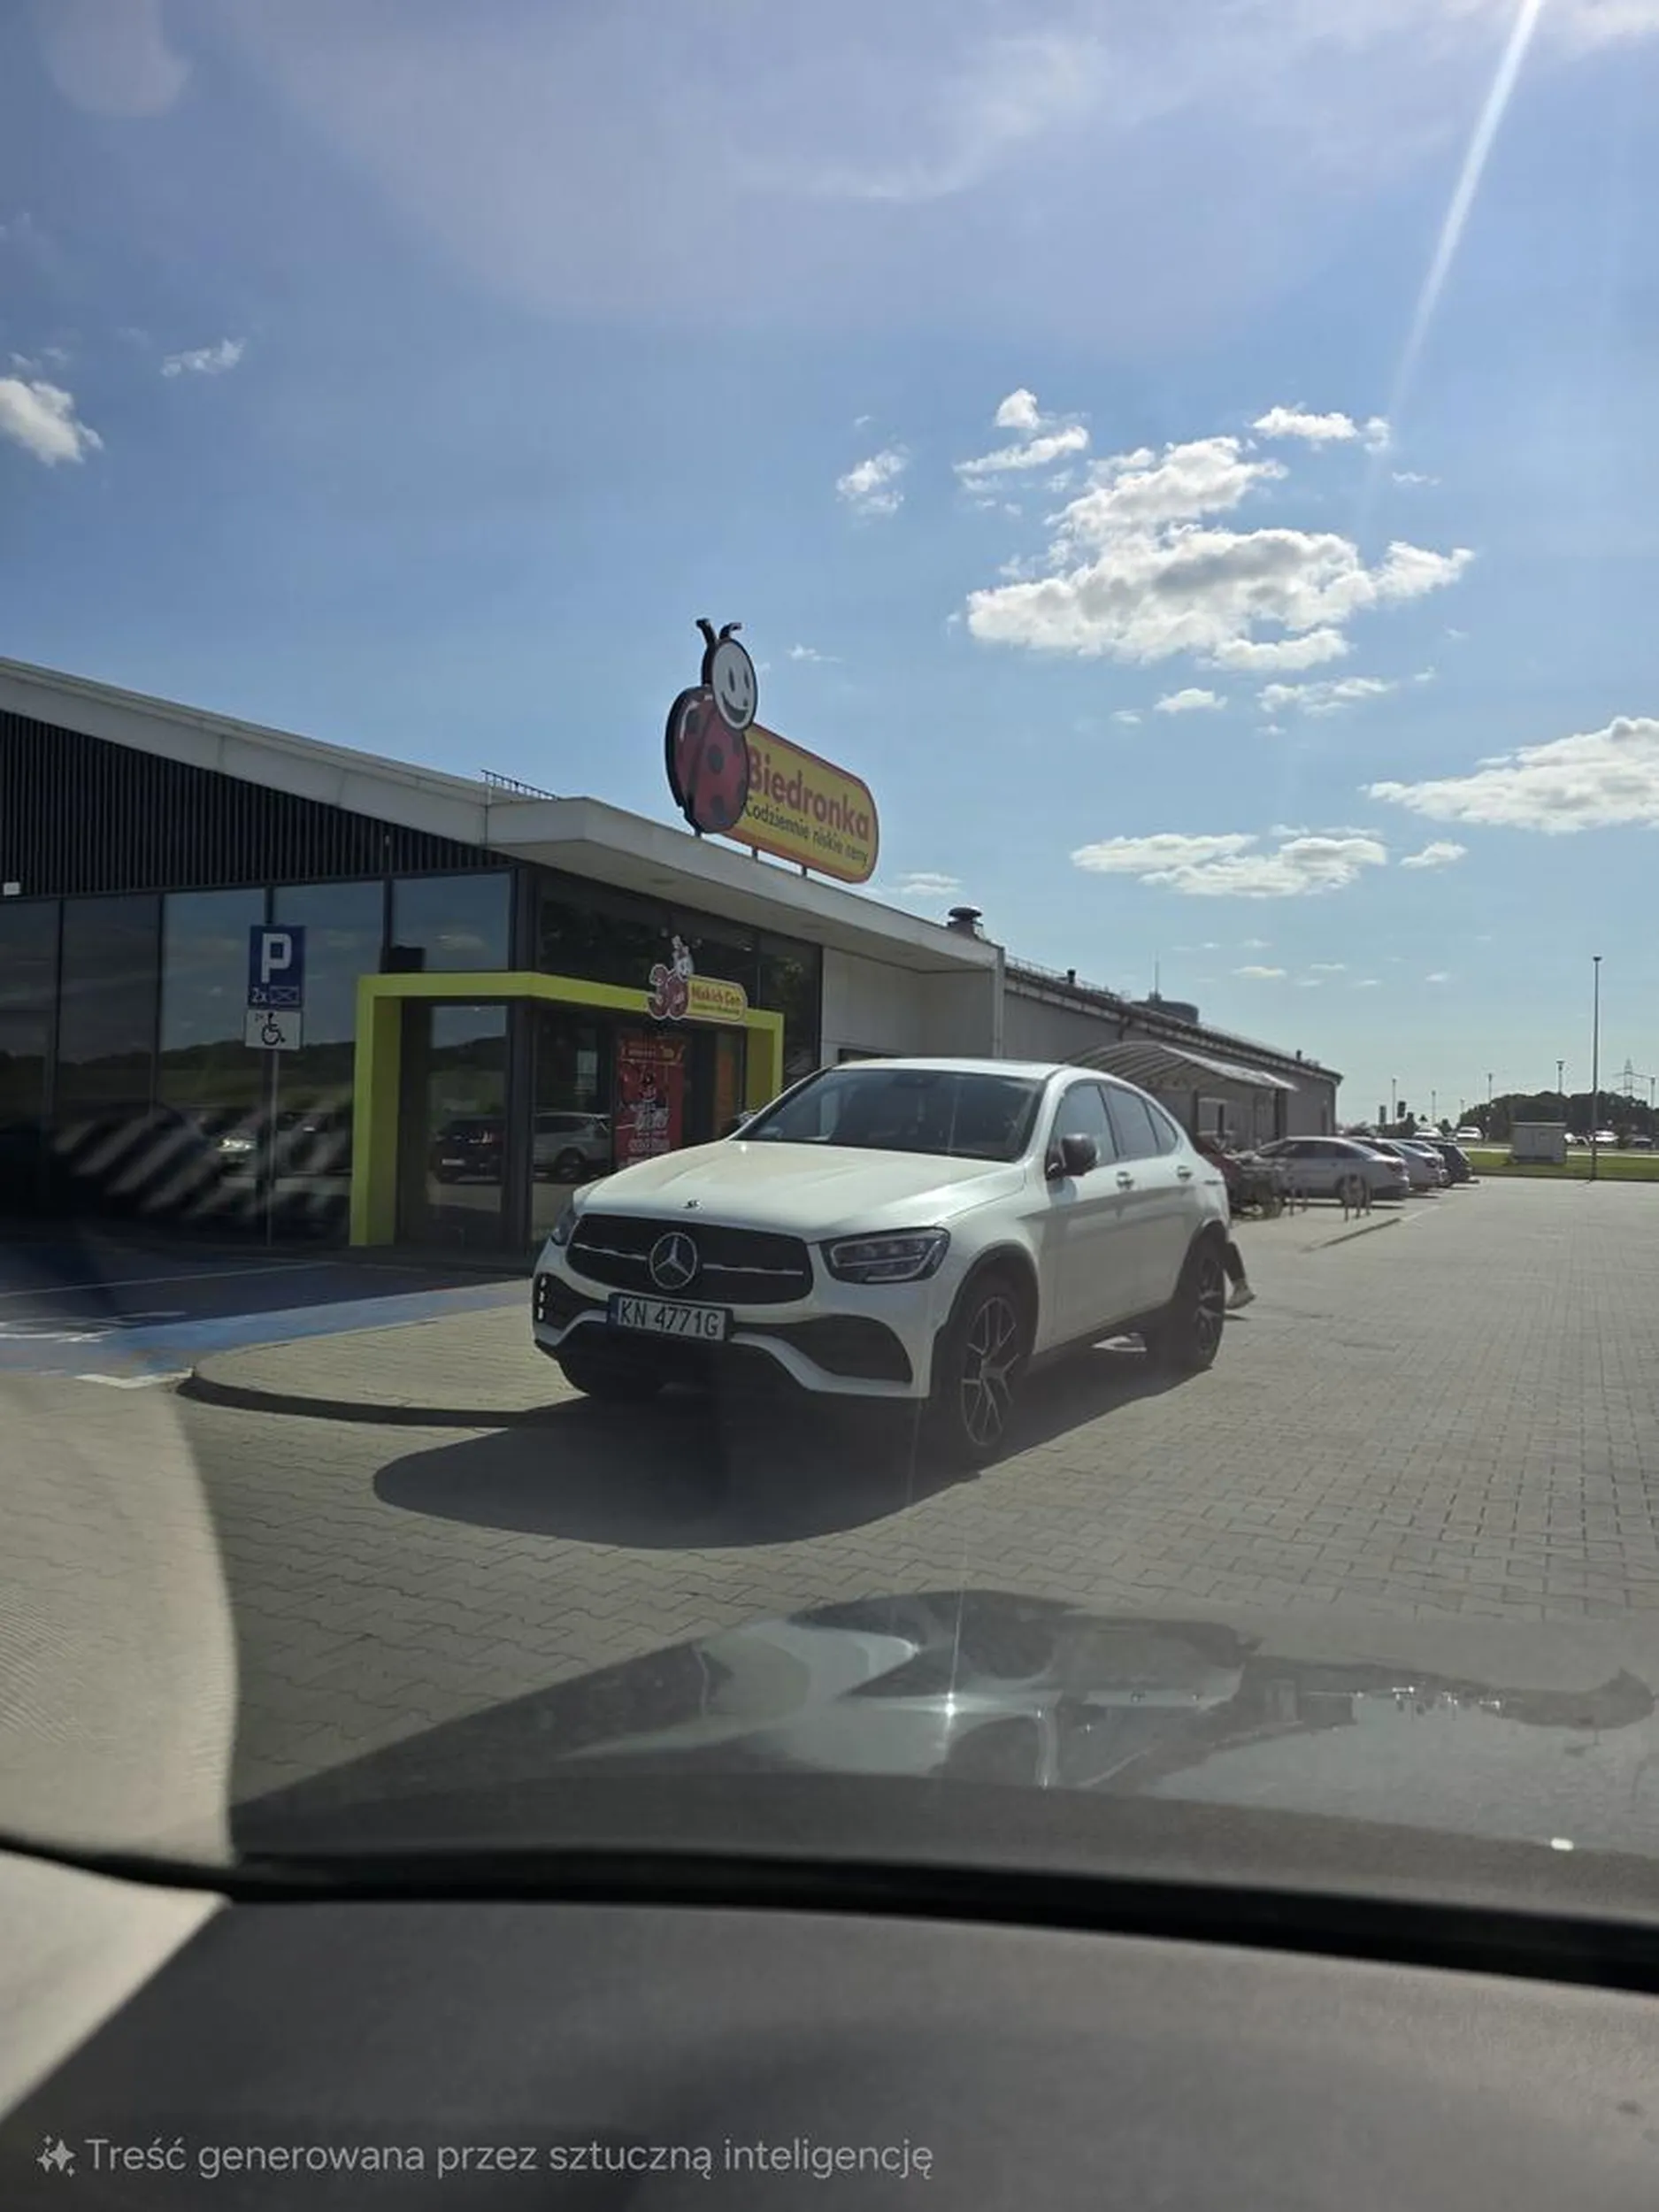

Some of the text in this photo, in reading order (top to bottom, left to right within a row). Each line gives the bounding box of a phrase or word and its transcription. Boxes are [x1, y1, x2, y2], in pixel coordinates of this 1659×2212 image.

[749, 745, 870, 841] Biedronka
[261, 933, 292, 983] P
[620, 1300, 718, 1337] KN 4771G
